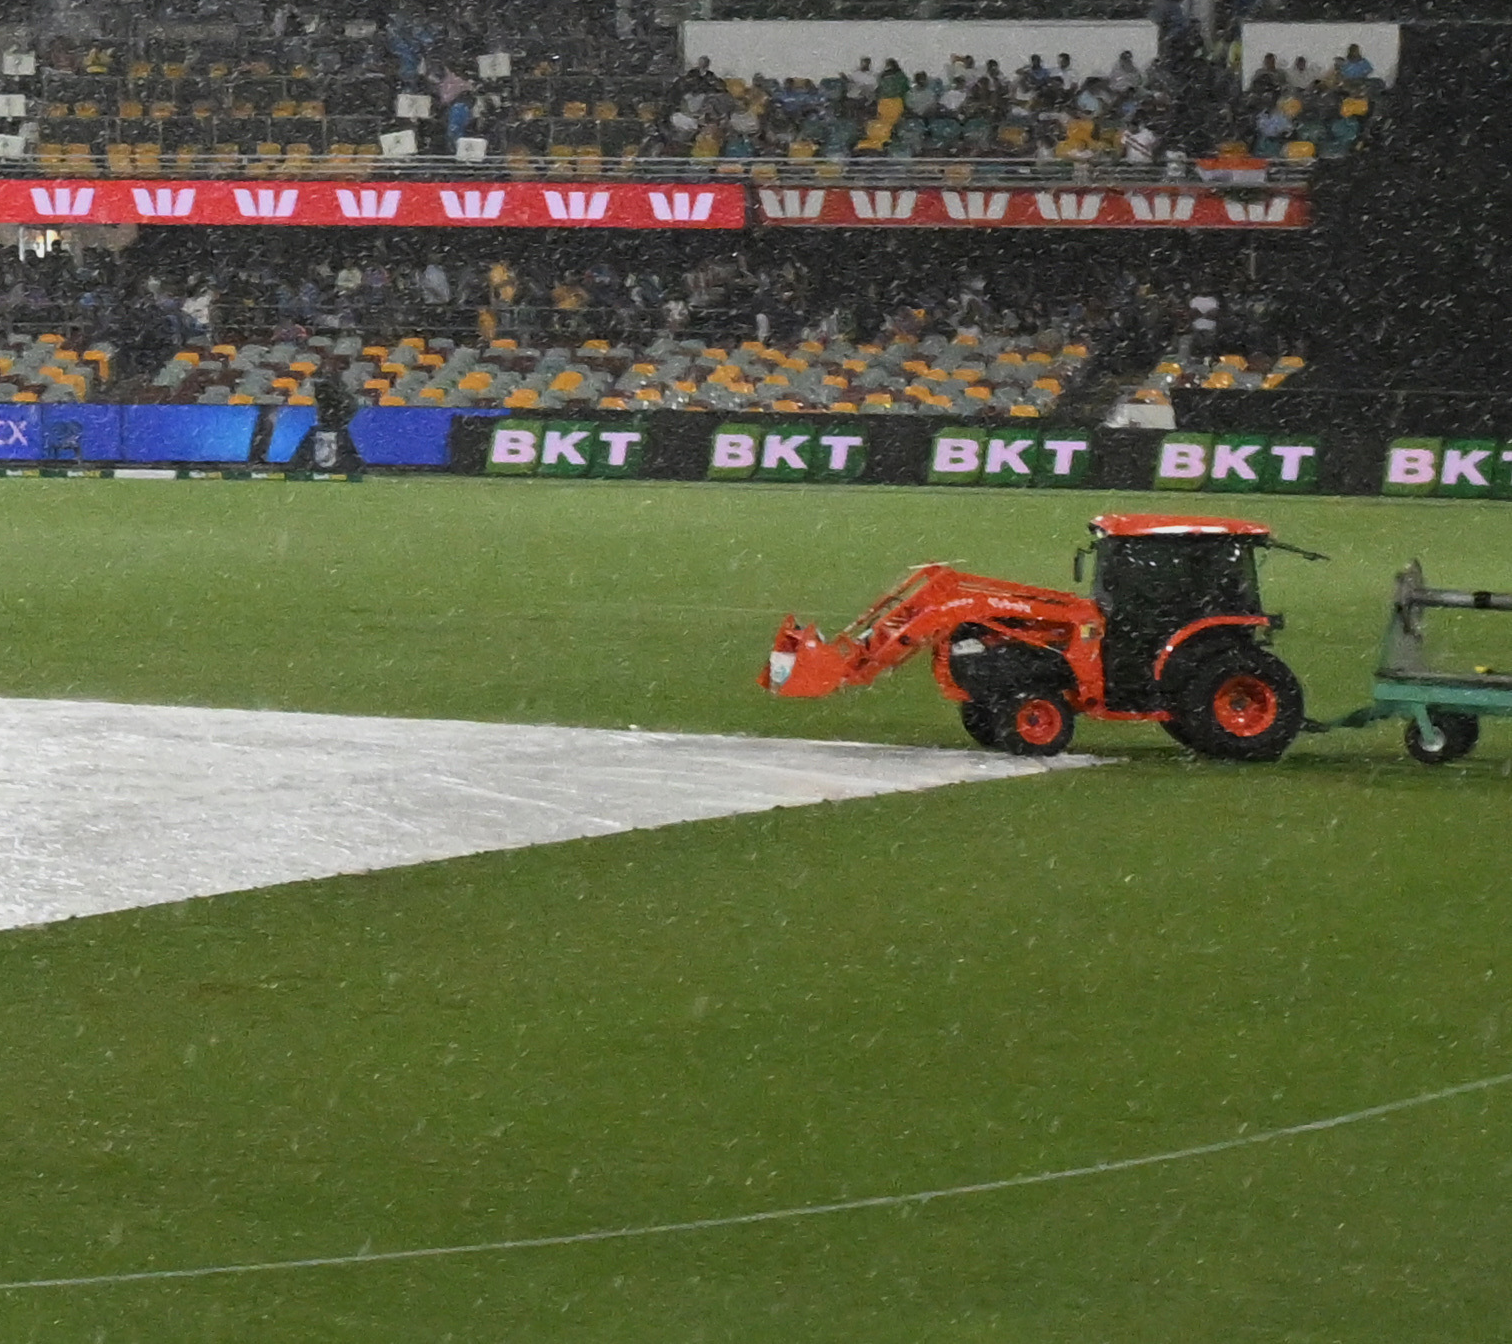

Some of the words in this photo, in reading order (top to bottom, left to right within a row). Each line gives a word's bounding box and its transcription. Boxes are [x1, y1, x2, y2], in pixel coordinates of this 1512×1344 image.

[492, 431, 639, 464] BKT
[715, 435, 861, 468] BKT
[935, 439, 1086, 473] BKT
[1161, 444, 1313, 479] BKT
[1390, 449, 1512, 484] BK
